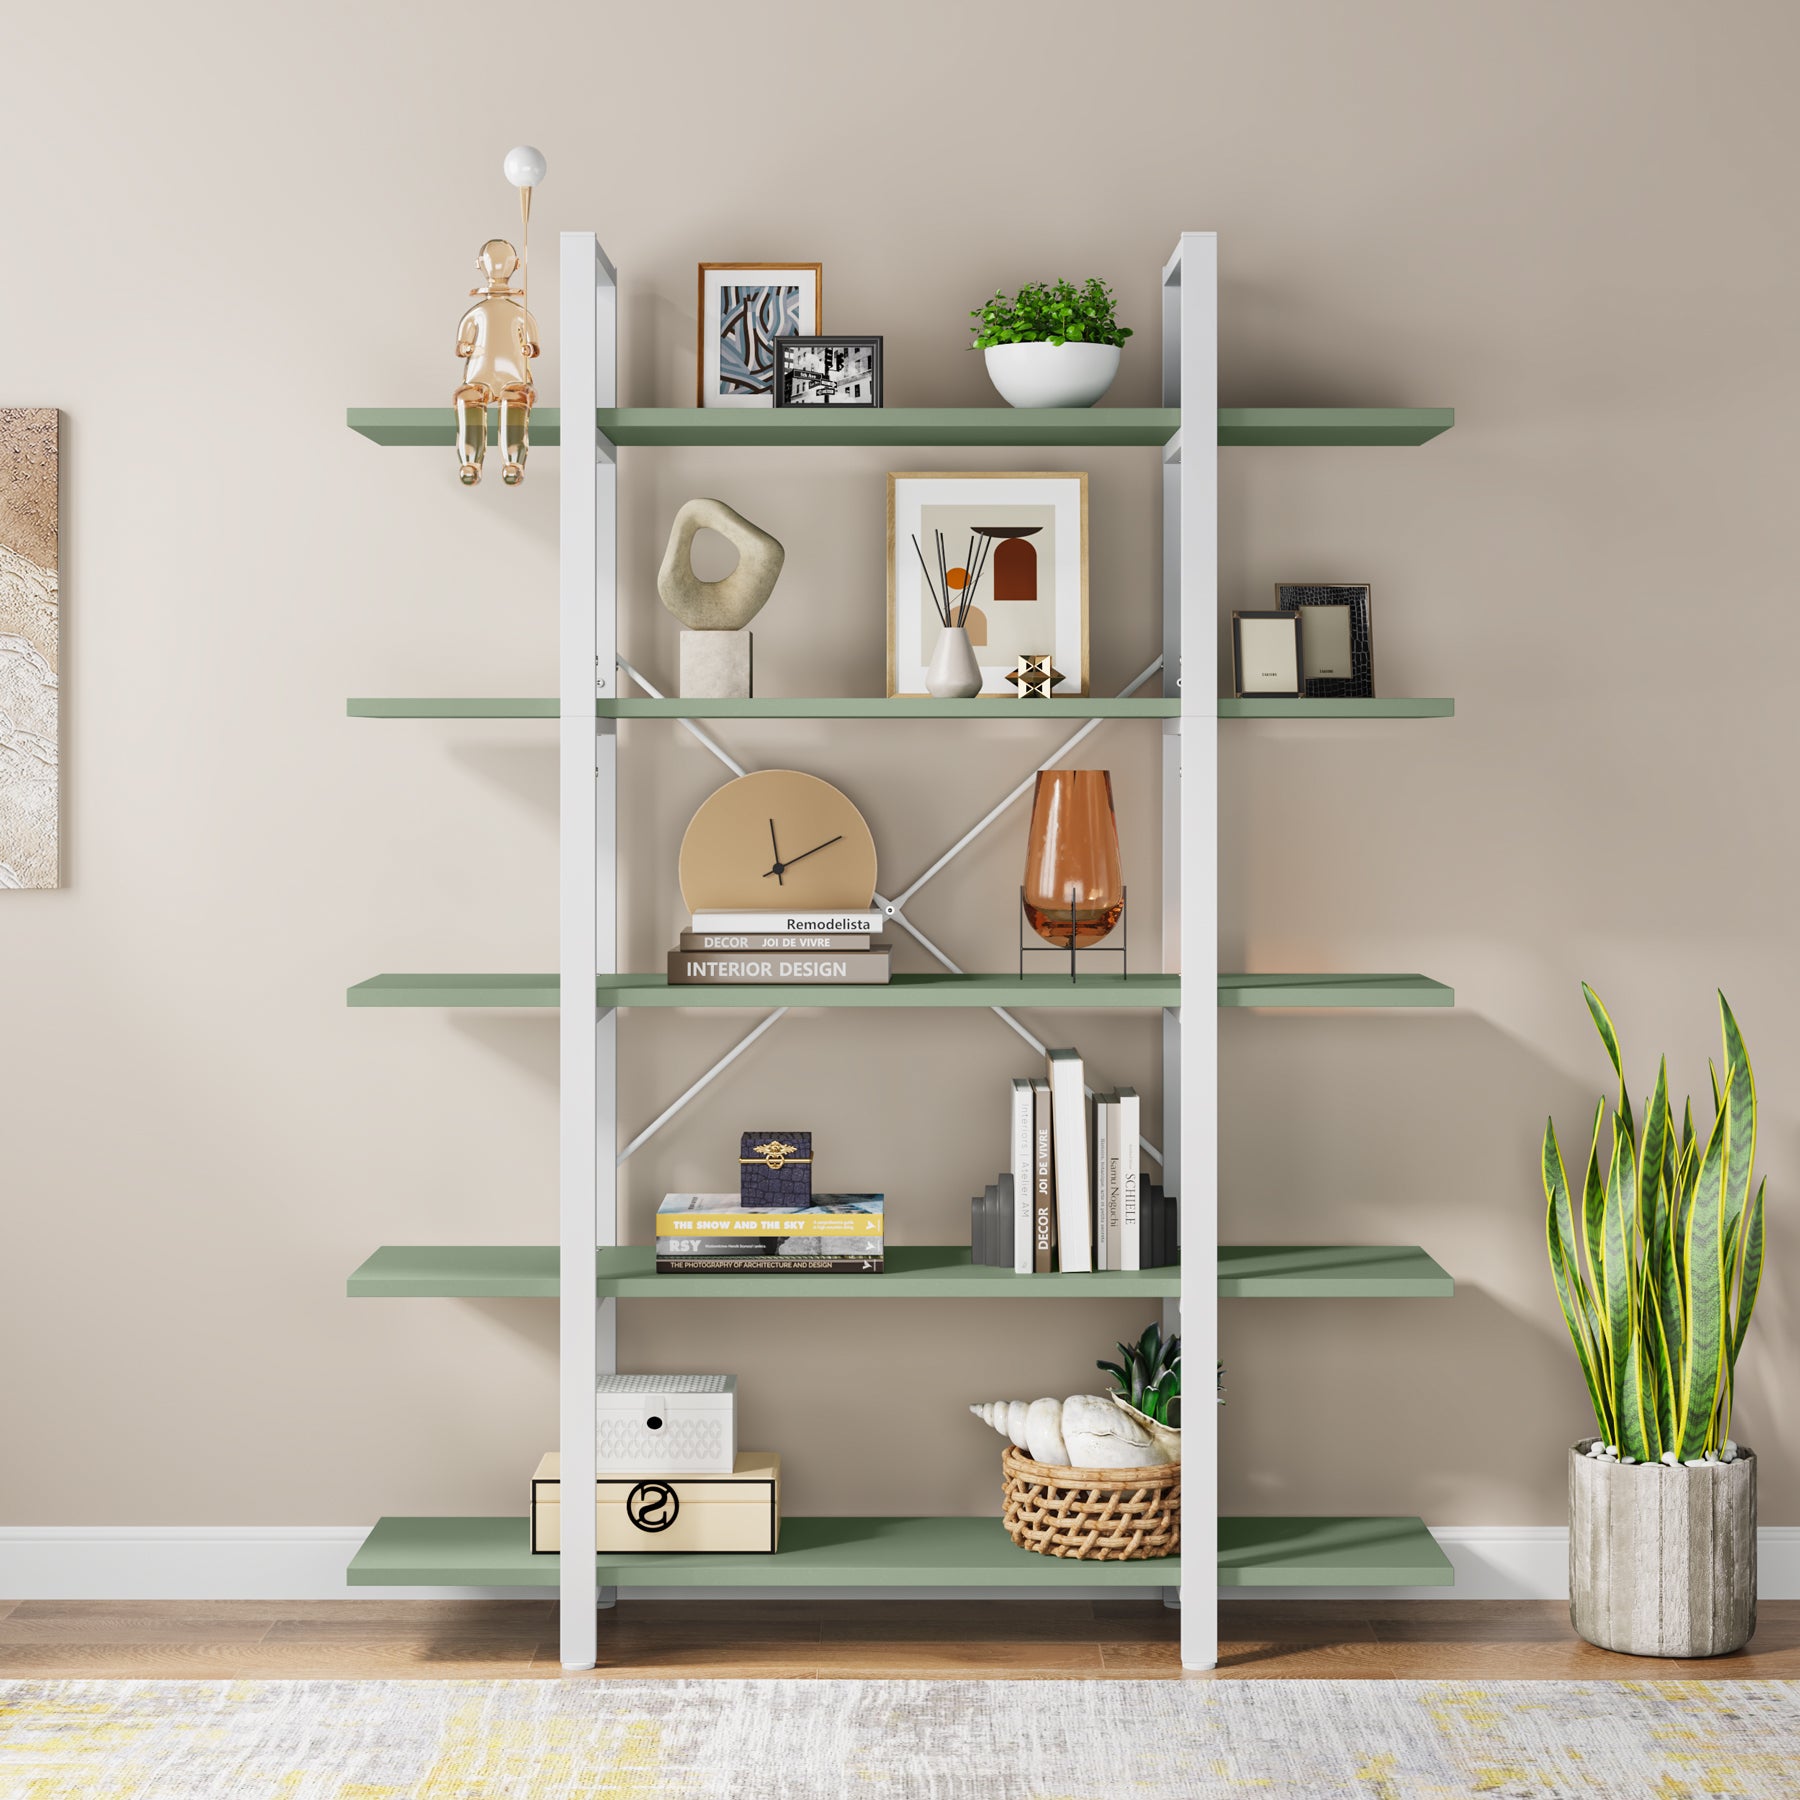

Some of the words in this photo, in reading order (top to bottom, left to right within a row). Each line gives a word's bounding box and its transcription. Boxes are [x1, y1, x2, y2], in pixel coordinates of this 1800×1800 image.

[787, 918, 871, 931] Remodelista
[704, 937, 748, 948] DECOR
[762, 938, 779, 948] JOI
[783, 938, 796, 947] DE
[800, 938, 830, 947] VIVRE
[687, 962, 773, 977] INTERIOR
[779, 962, 847, 977] DESIGN
[1020, 1103, 1030, 1149] Interiors
[1039, 1129, 1048, 1159] VIVRE
[1039, 1162, 1048, 1175] DE
[1110, 1157, 1120, 1185] Isamu
[1020, 1162, 1030, 1198] Atelier
[1039, 1179, 1048, 1195] JOI
[1108, 1187, 1120, 1227] Noguchi
[1125, 1173, 1136, 1225] SCHIELE
[1021, 1202, 1030, 1218] AM
[673, 1221, 693, 1230] THE
[696, 1221, 730, 1230] SNOW
[733, 1221, 758, 1230] AND
[761, 1221, 780, 1230] THE
[784, 1221, 805, 1230] SKY
[1038, 1207, 1049, 1250] DECOR
[669, 1240, 702, 1253] RSY
